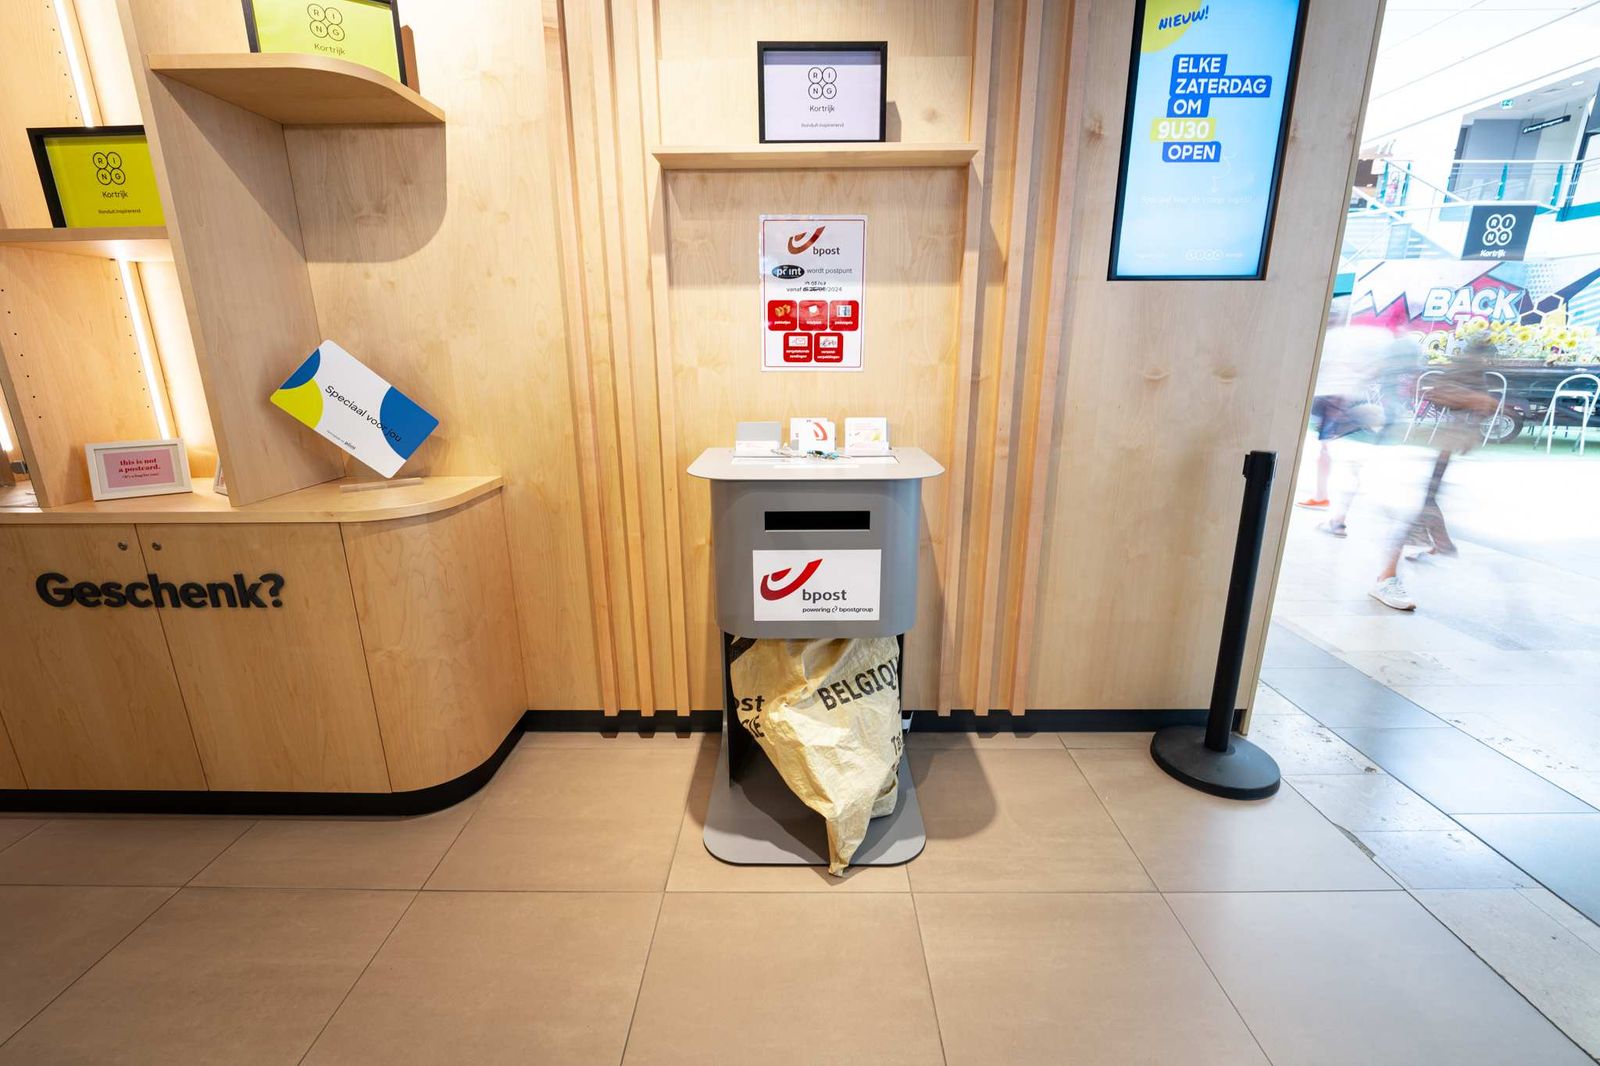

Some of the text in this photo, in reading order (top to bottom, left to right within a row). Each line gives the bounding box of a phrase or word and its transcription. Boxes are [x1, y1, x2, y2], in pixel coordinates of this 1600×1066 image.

[1159, 5, 1209, 30] NIEUW!
[314, 43, 345, 55] Kortrijk
[1178, 57, 1221, 73] ELKE
[1175, 78, 1267, 94] ZATERDAG
[810, 104, 835, 113] Kortrijk
[1173, 99, 1201, 115] OM
[1157, 120, 1210, 139] 9U30
[1168, 144, 1216, 160] OPEN
[101, 190, 129, 199] Kortrijk
[813, 246, 840, 256] bpost
[1480, 249, 1506, 258] Kortrijk
[1422, 287, 1522, 322] BACK
[325, 385, 402, 442] Speciaal voor jou
[36, 572, 285, 608] Geschenk?
[802, 589, 847, 604] bpost
